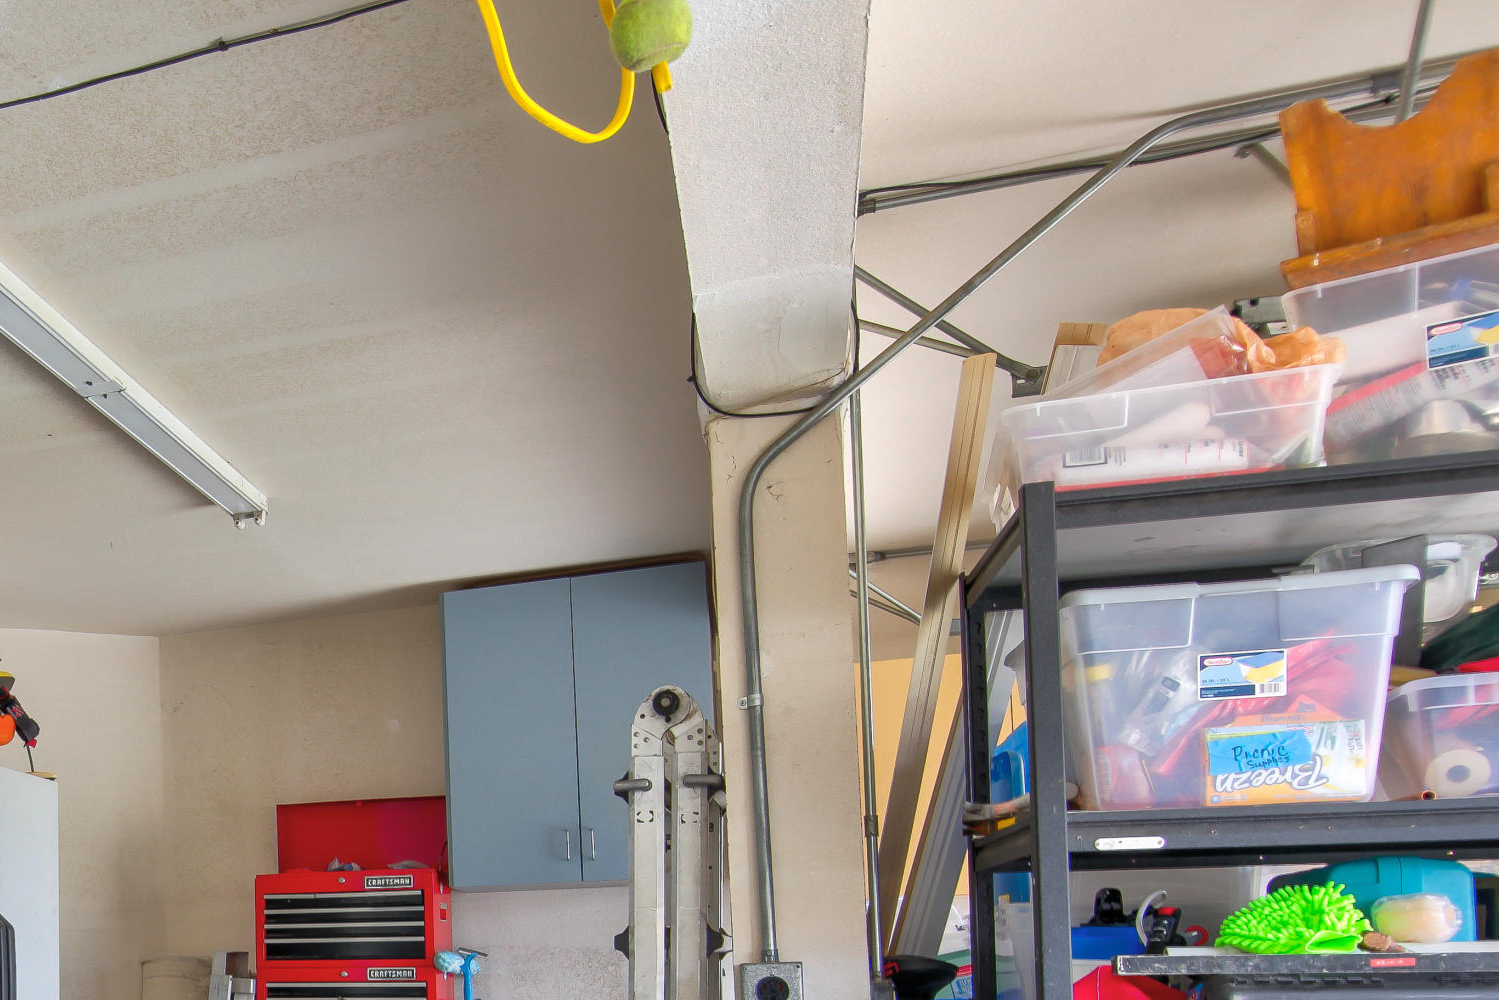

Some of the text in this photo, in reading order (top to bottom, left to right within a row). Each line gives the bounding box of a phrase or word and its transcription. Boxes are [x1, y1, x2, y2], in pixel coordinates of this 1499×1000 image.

[1232, 744, 1289, 762] Picnic
[367, 878, 410, 887] CRAFTSMAN
[370, 970, 413, 978] CRAFTSMAN
